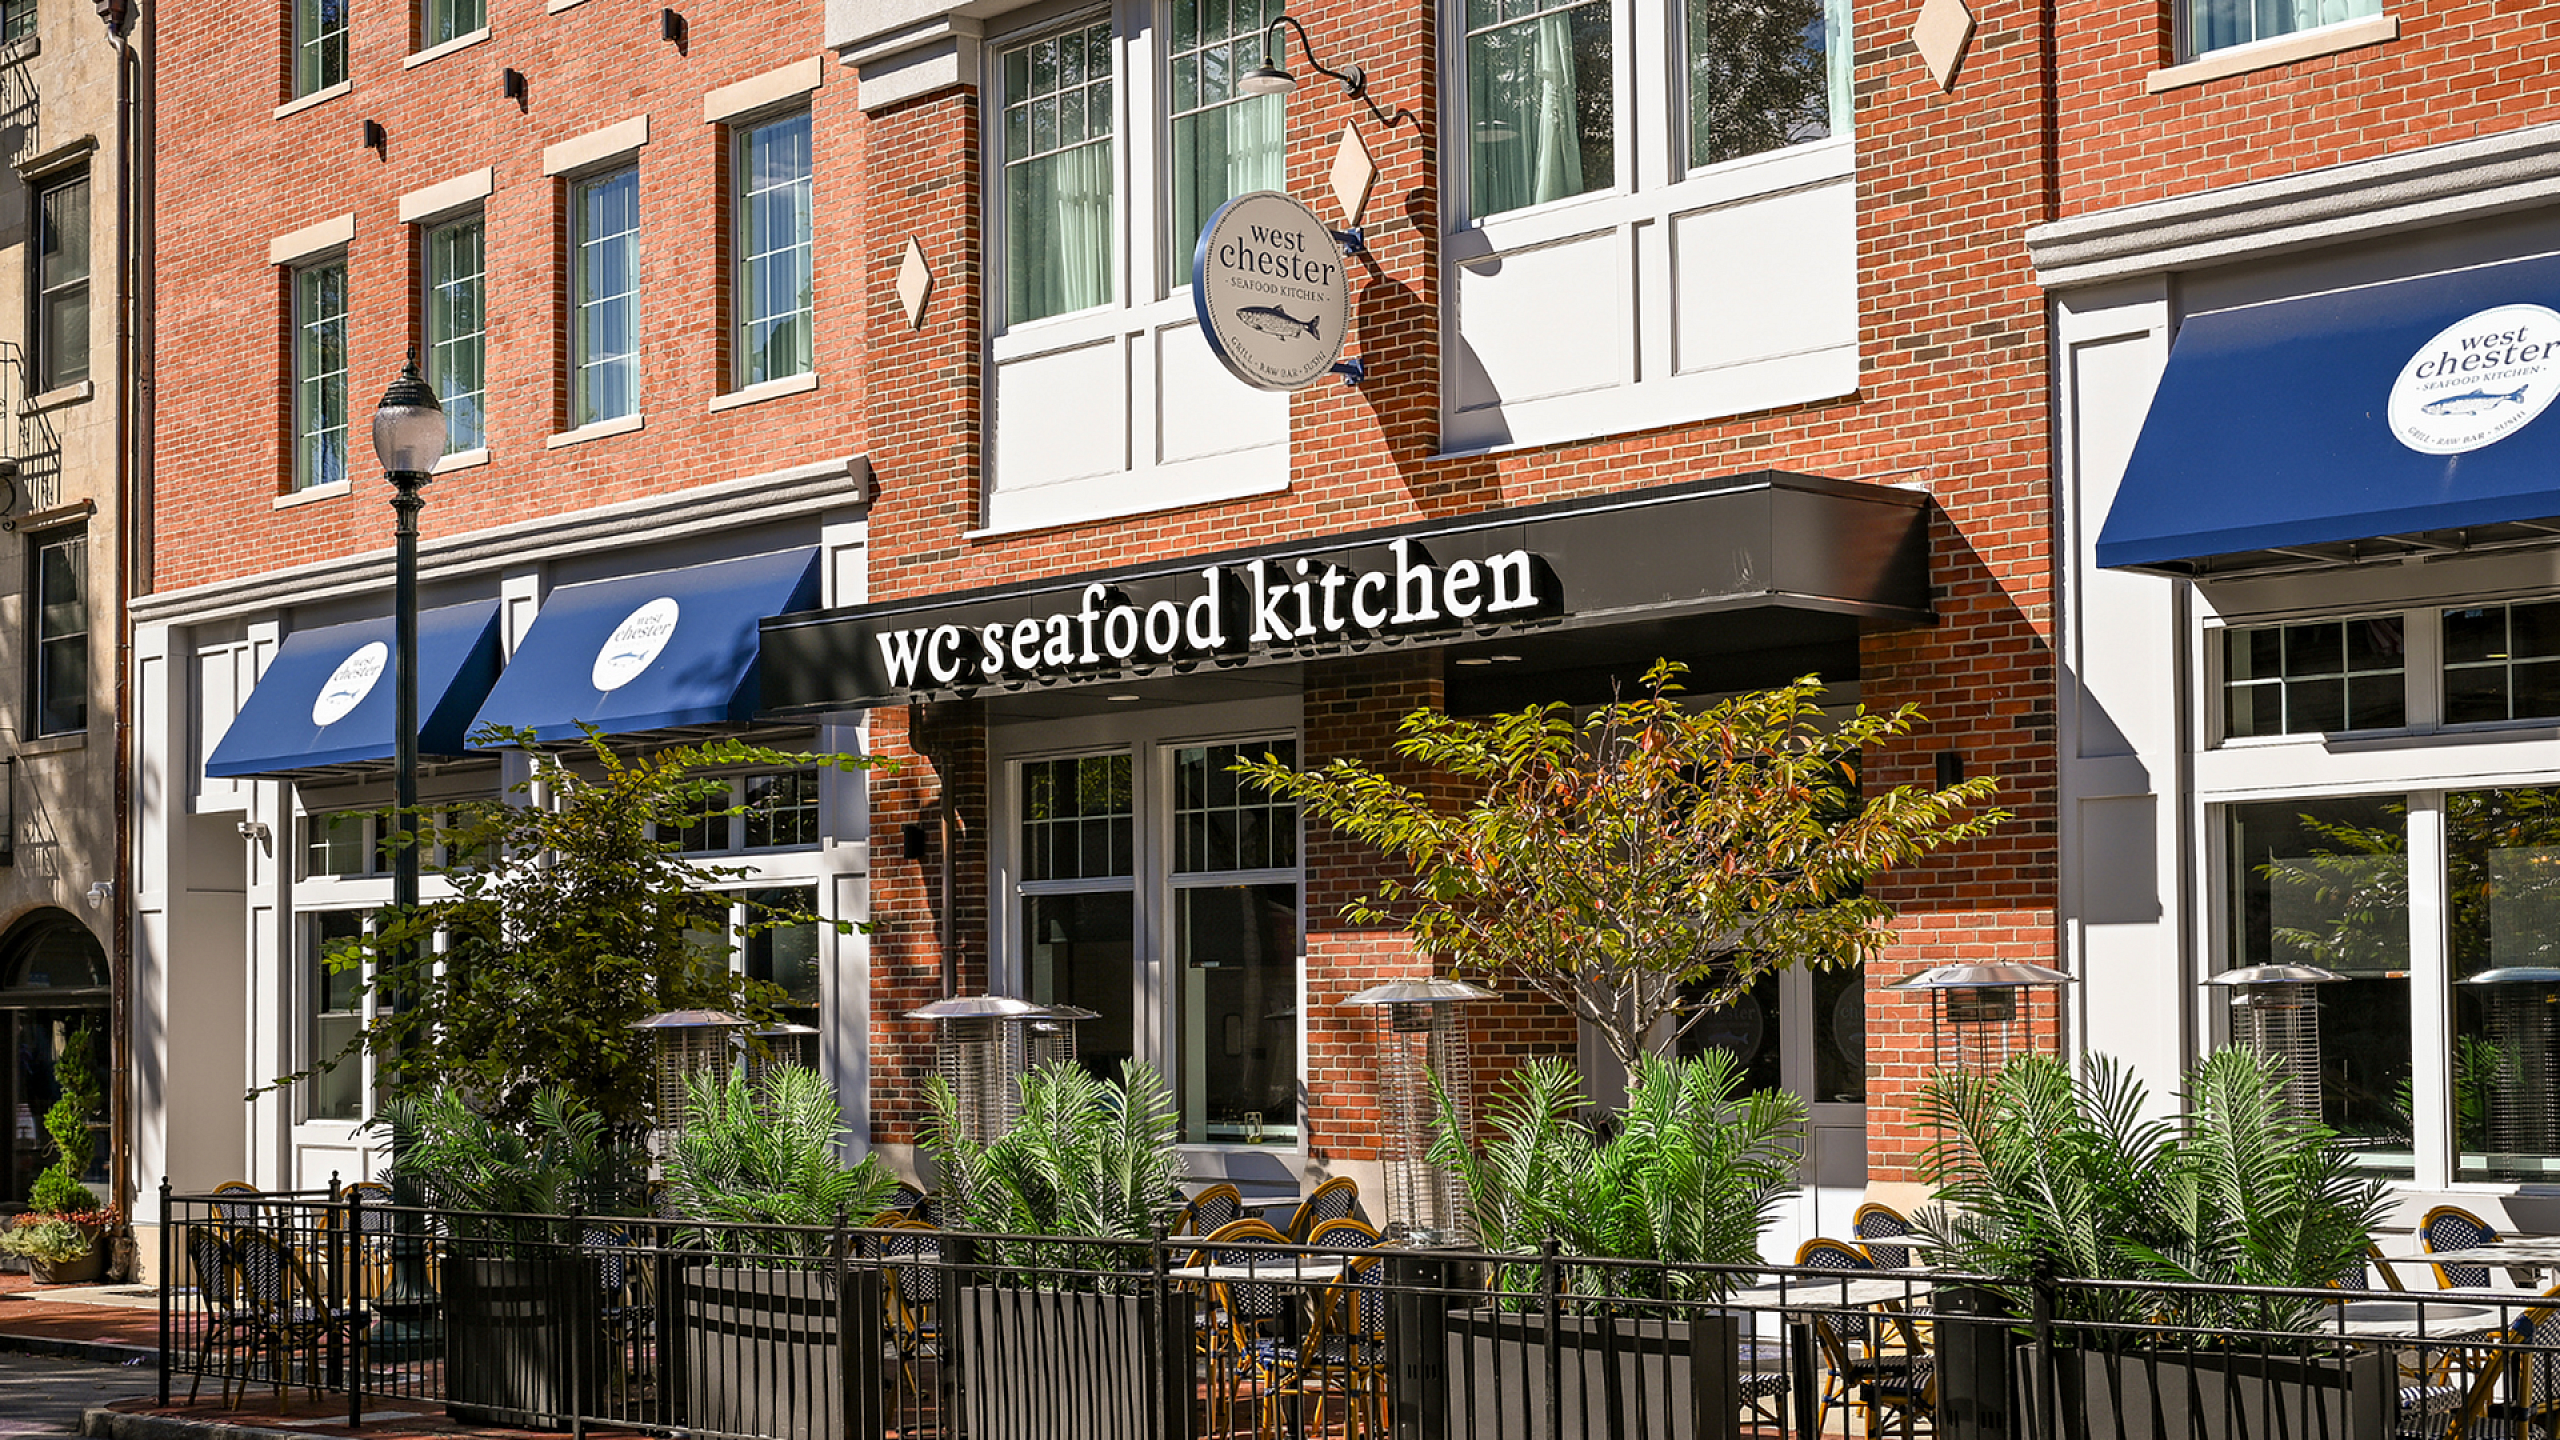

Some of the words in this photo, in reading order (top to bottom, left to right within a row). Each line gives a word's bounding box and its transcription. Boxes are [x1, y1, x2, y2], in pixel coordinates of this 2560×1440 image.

[1250, 225, 1305, 253] west
[1220, 236, 1336, 286] chester
[1231, 277, 1278, 294] SEAFOOD
[1280, 286, 1325, 302] KITCHEN
[2461, 325, 2529, 351] west
[1231, 336, 1253, 363] GRILL
[1260, 362, 1279, 376] RAW
[1304, 350, 1326, 373] SUSHI
[2416, 340, 2560, 379] chester
[2423, 375, 2480, 391] SEAFOOD
[2483, 366, 2540, 382] KITCHEN
[2408, 427, 2430, 443] GRILL
[2436, 437, 2460, 445] RAW
[2463, 432, 2485, 444] BAR
[876, 630, 961, 689] wc
[982, 568, 1225, 675] seafood
[1246, 537, 1540, 641] kitchen
[614, 623, 671, 642] chester
